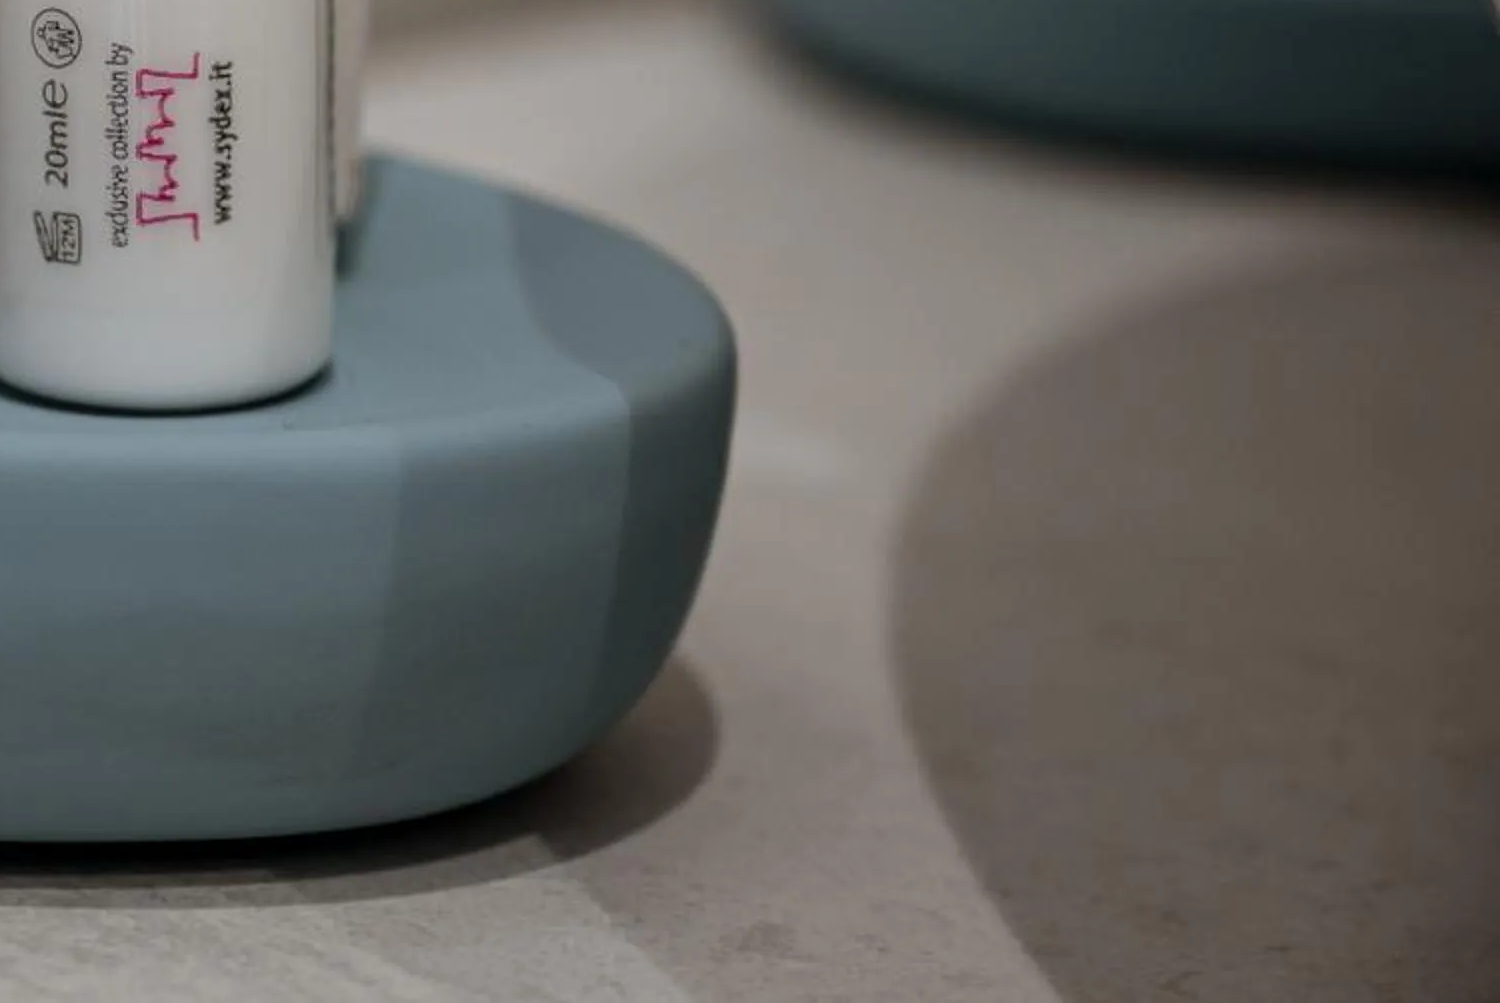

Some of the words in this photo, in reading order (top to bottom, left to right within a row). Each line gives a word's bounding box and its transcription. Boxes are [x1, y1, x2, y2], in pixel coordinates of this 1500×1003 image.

[105, 42, 135, 66] by
[105, 71, 129, 161] collection
[207, 60, 238, 225] www.sydex.it
[105, 164, 129, 248] exclusive
